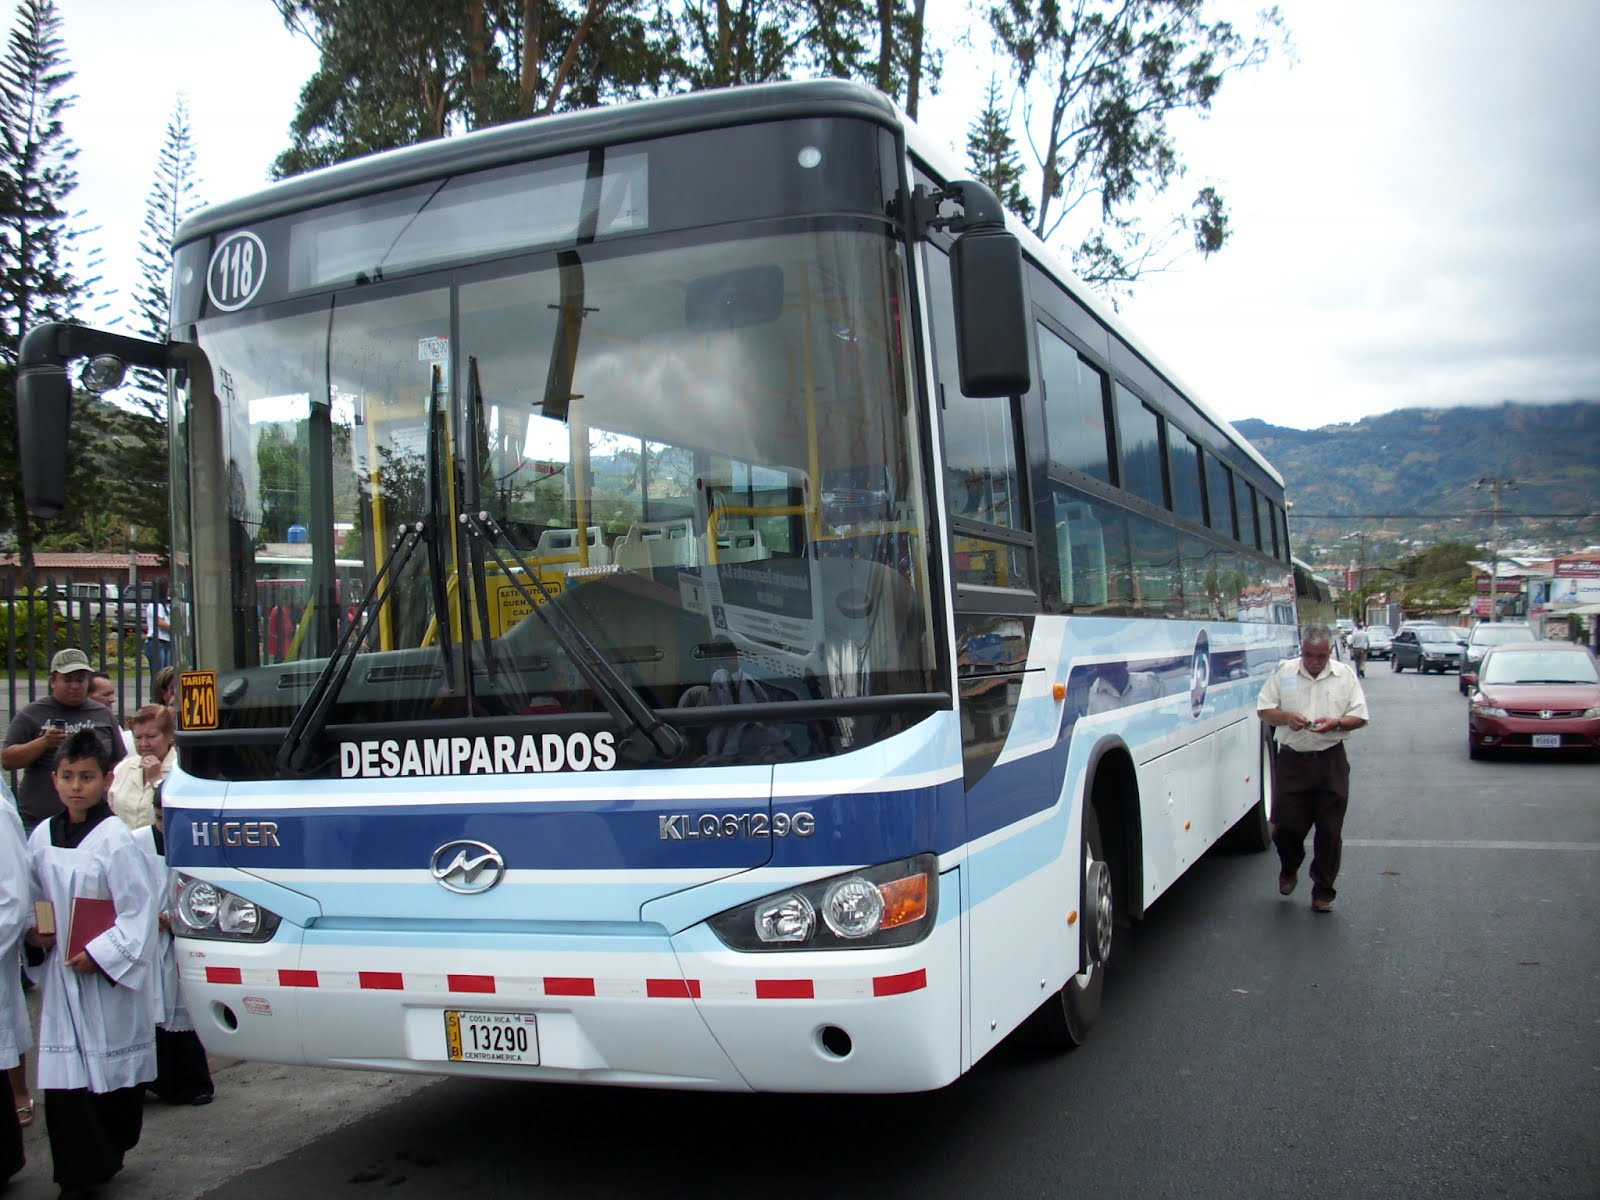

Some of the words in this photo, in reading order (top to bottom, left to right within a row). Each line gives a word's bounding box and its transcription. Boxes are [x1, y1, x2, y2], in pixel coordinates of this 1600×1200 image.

[220, 241, 254, 301] 118
[182, 675, 213, 686] TARIFA
[340, 731, 616, 777] DESAMPARADOS
[191, 821, 281, 847] HIGER
[658, 812, 815, 840] KLQ6129G
[469, 1015, 492, 1023] COSTA
[494, 1016, 511, 1024] RICA
[470, 1024, 528, 1052] 13290
[464, 1052, 522, 1062] CENTROAMERICA
